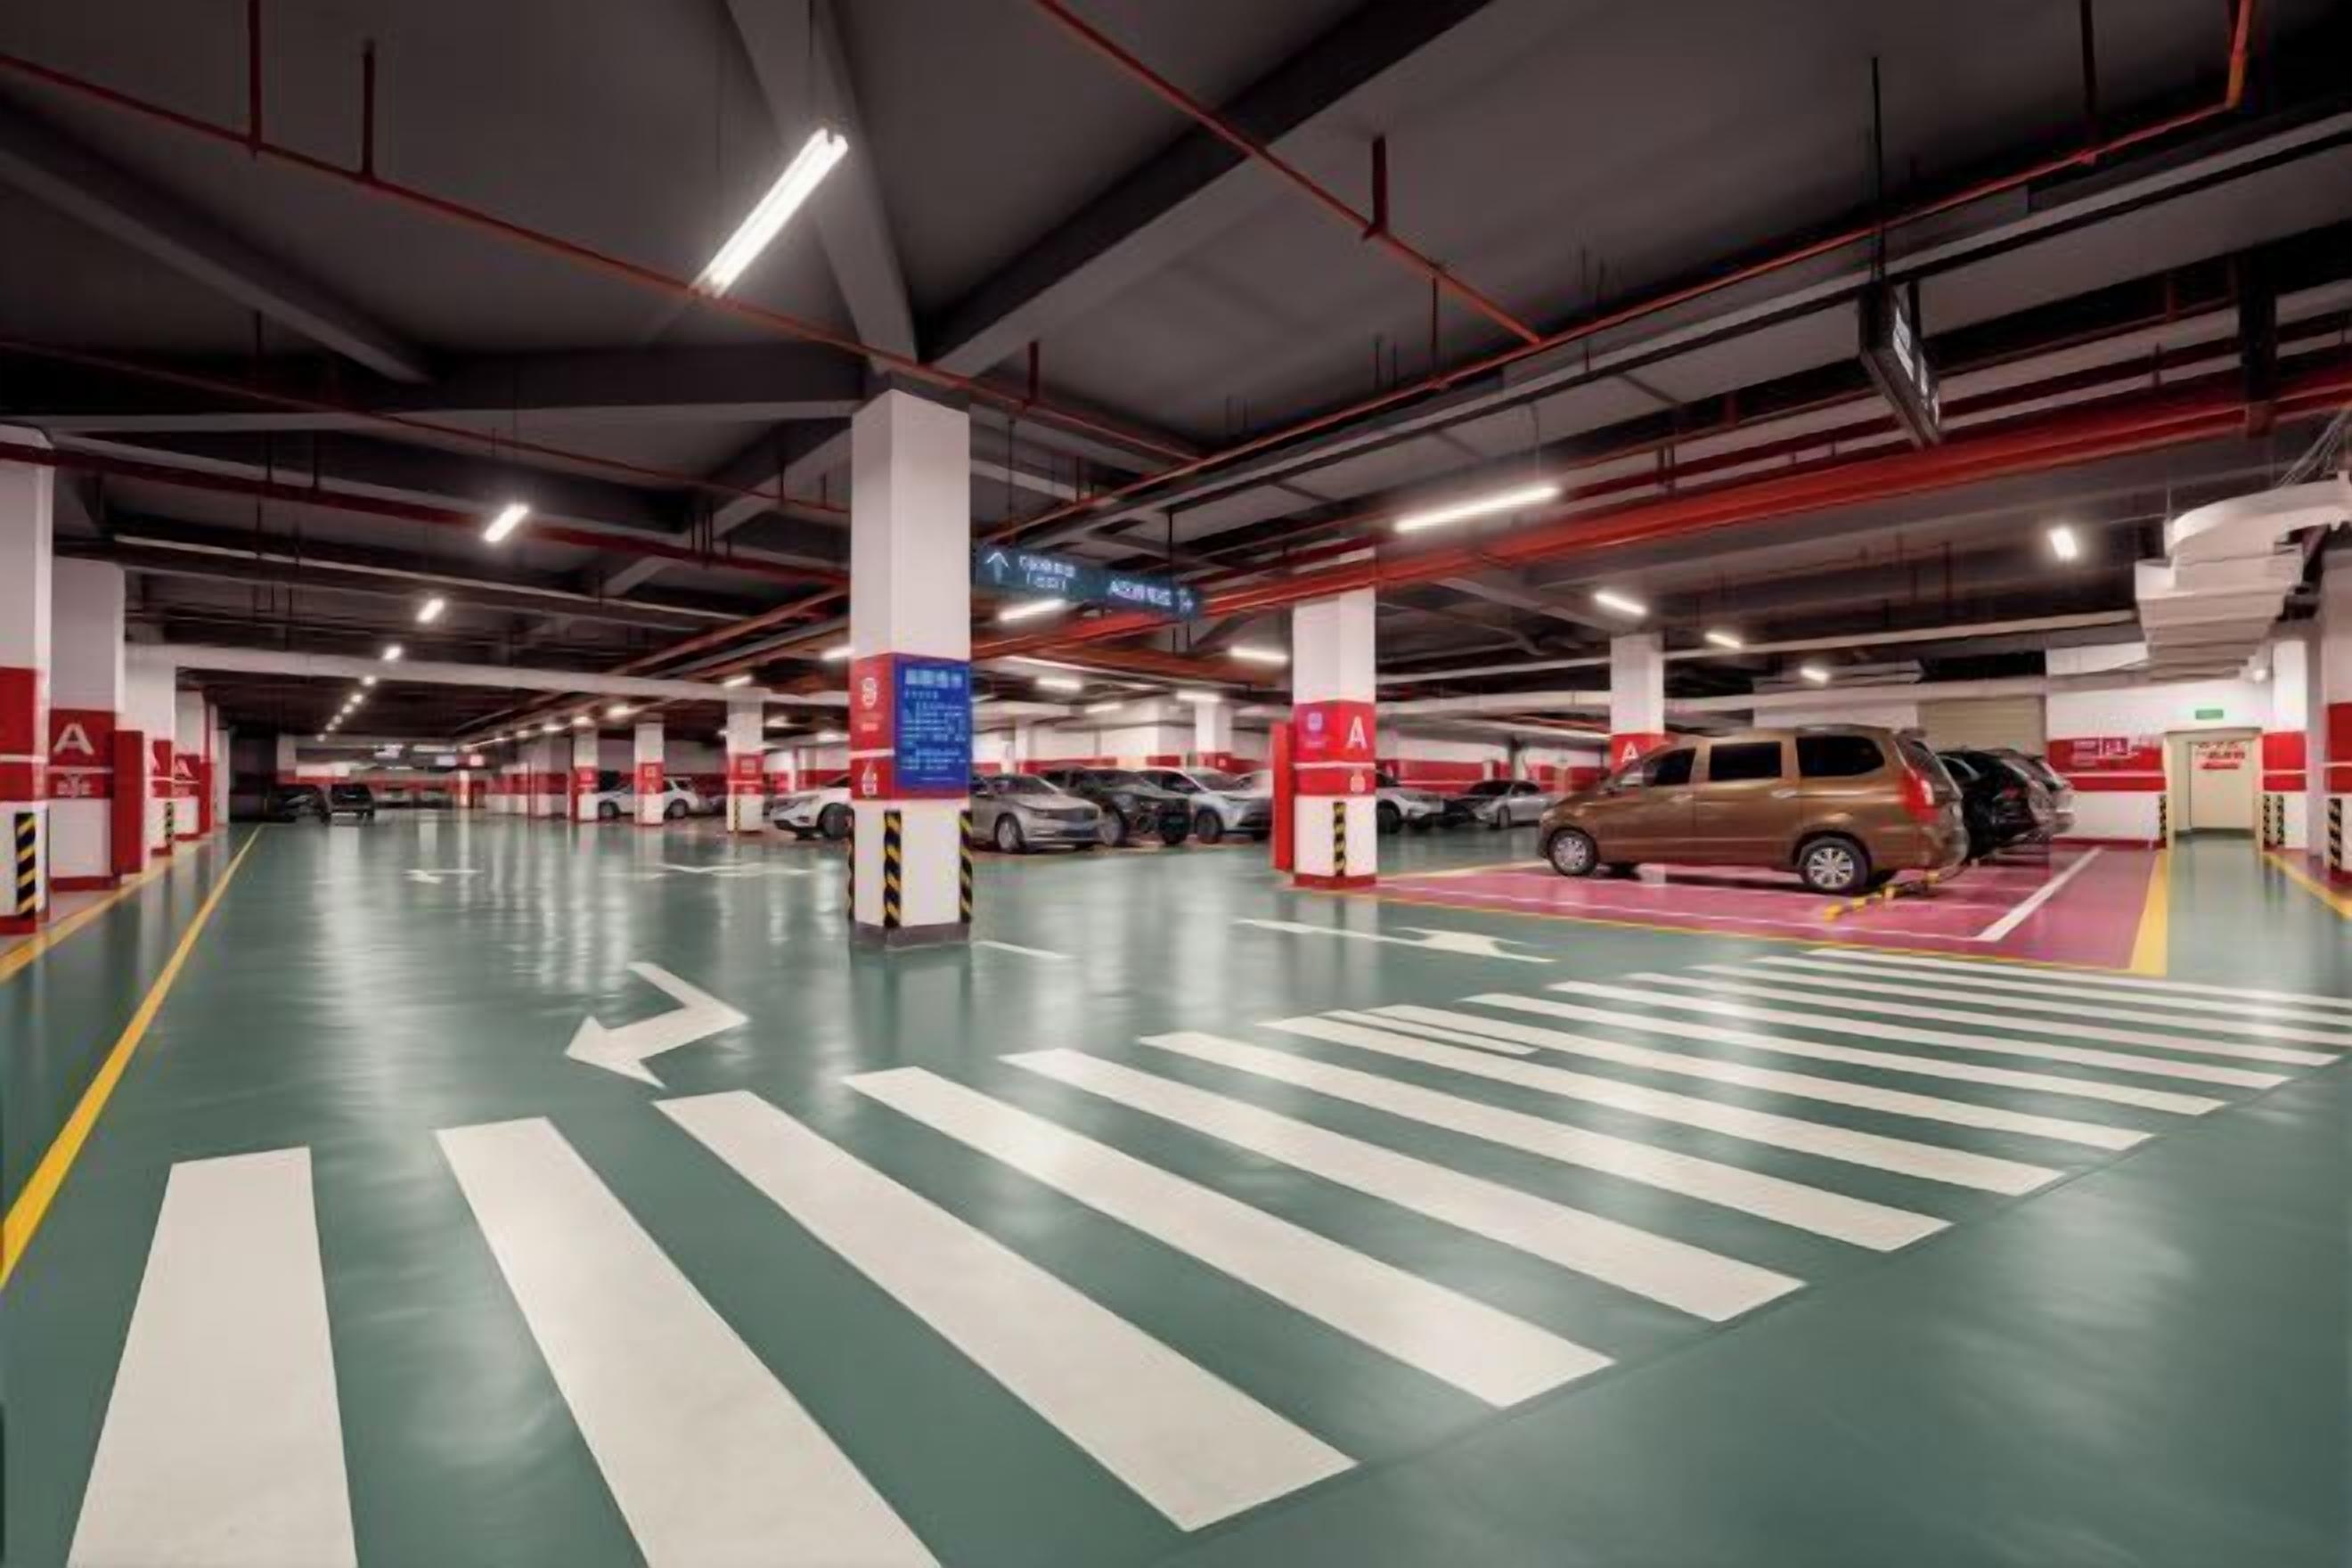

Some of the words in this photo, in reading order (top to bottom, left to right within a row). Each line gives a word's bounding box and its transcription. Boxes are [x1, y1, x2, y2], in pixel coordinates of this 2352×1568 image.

[53, 723, 94, 755] A
[1346, 715, 1368, 749] A
[1621, 741, 1640, 764] A
